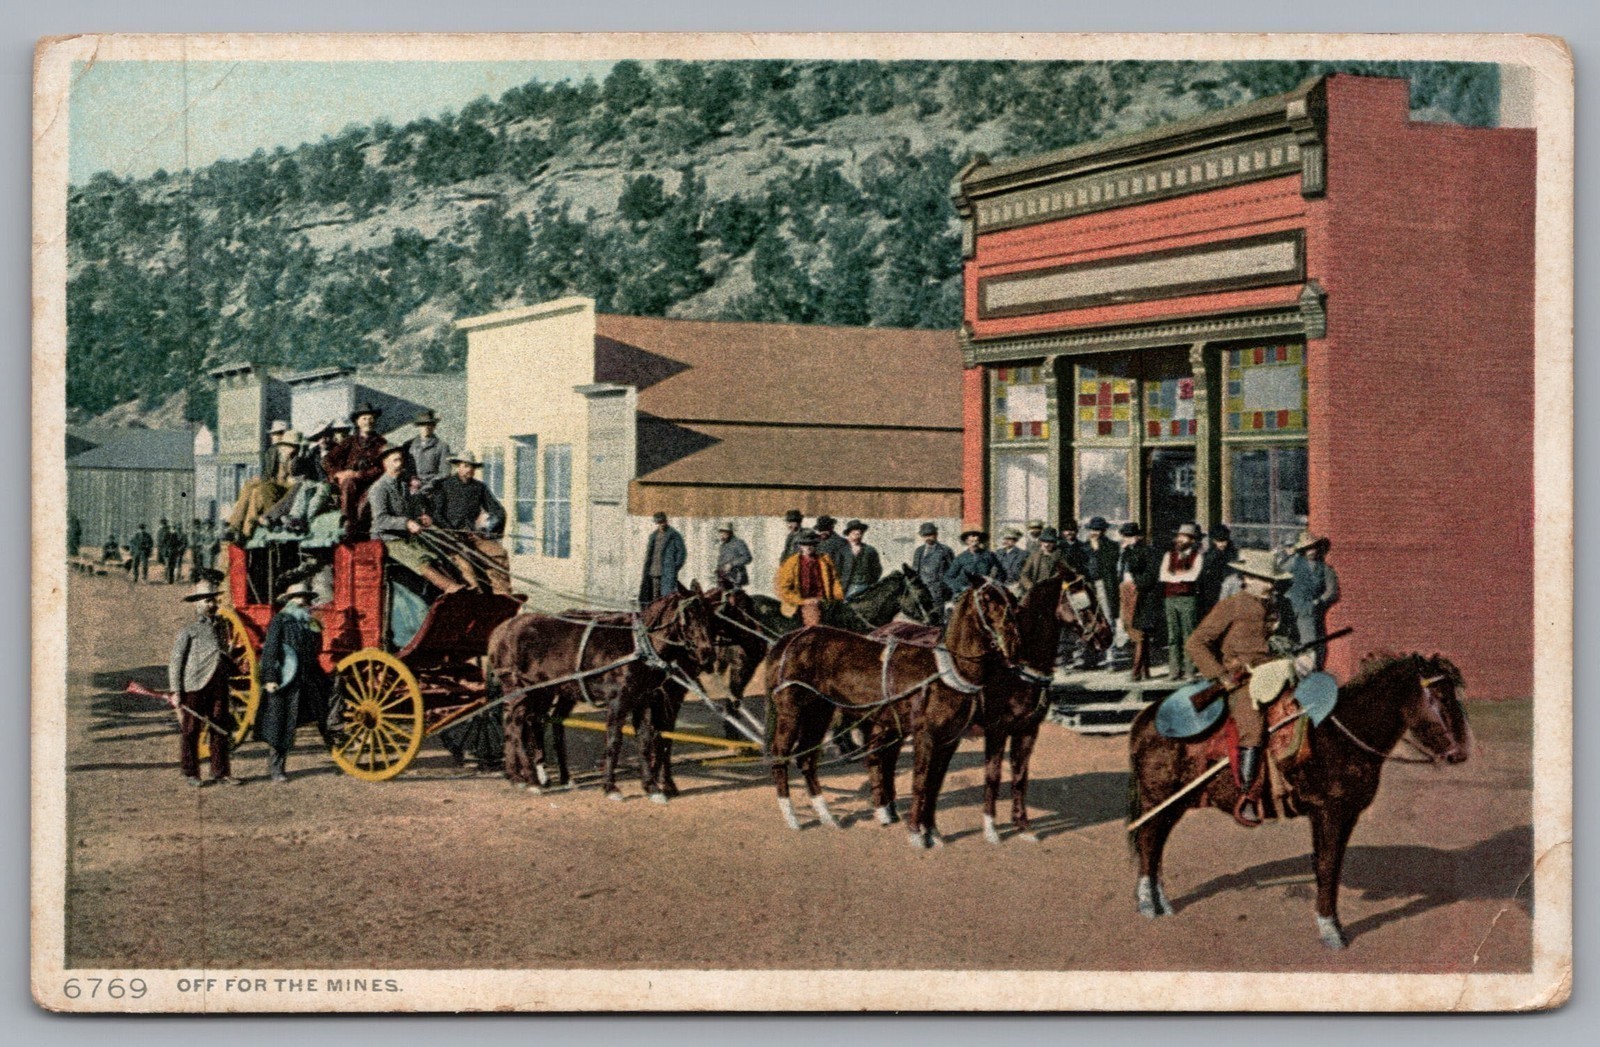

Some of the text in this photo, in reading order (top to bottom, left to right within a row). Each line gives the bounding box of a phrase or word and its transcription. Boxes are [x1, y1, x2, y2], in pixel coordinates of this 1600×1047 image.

[63, 977, 404, 999] 6769 OFF FOR THE MINES.
